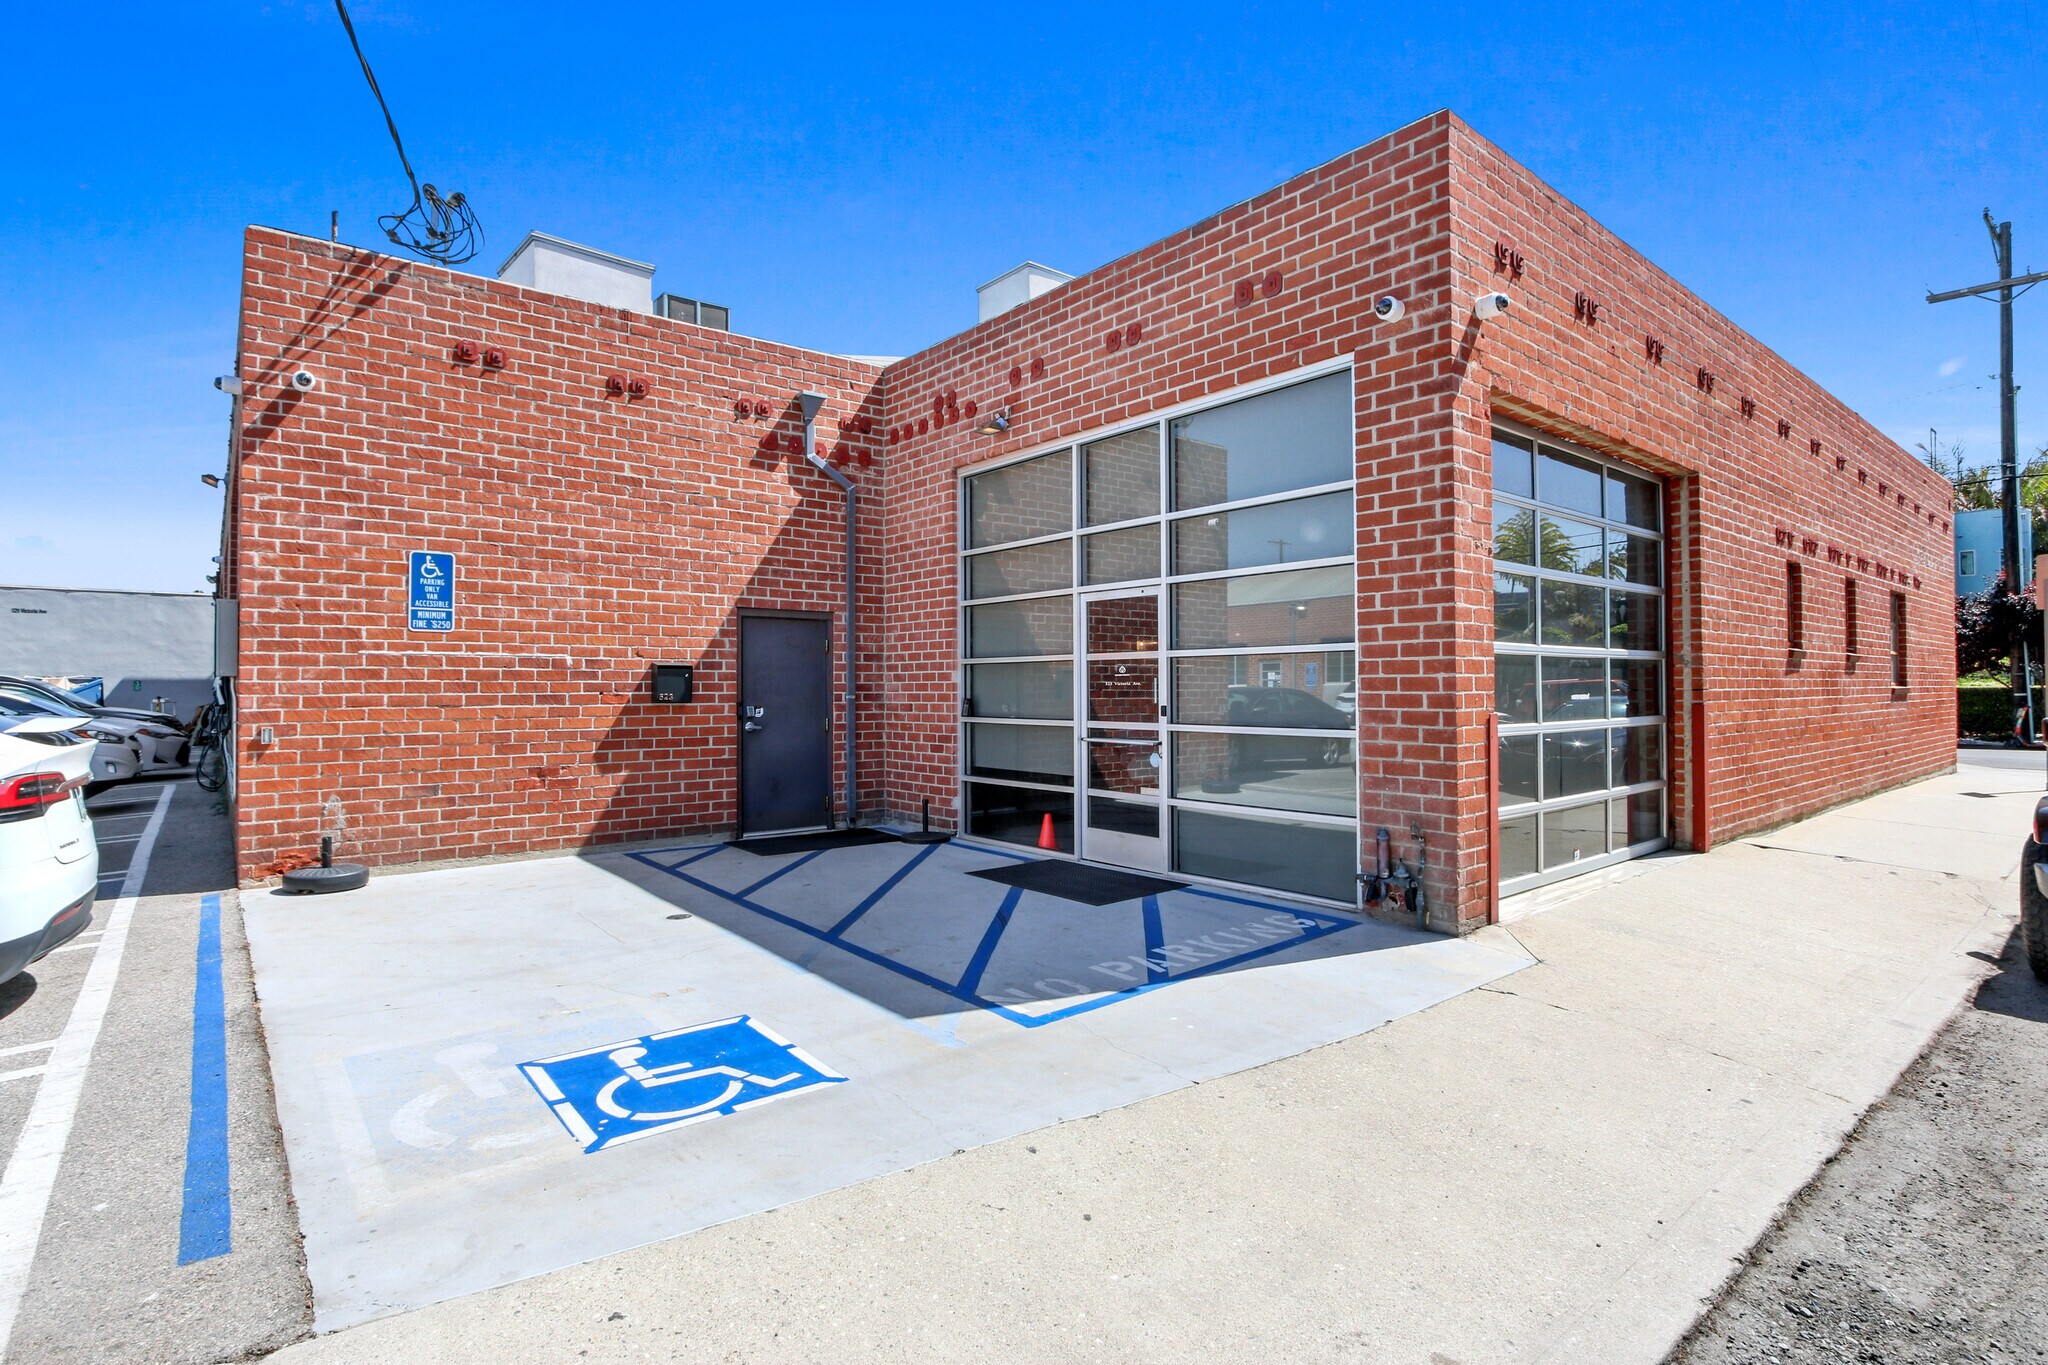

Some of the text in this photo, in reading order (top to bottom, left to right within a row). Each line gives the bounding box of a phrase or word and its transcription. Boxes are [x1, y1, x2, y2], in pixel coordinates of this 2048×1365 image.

[420, 577, 445, 586] PARKING
[424, 585, 440, 593] ONLY
[415, 599, 449, 608] ACCESSIBLE
[417, 610, 446, 619] MINIMUM
[412, 619, 451, 629] FINE $250
[659, 692, 674, 701] 523
[1088, 914, 1317, 982] PARKING
